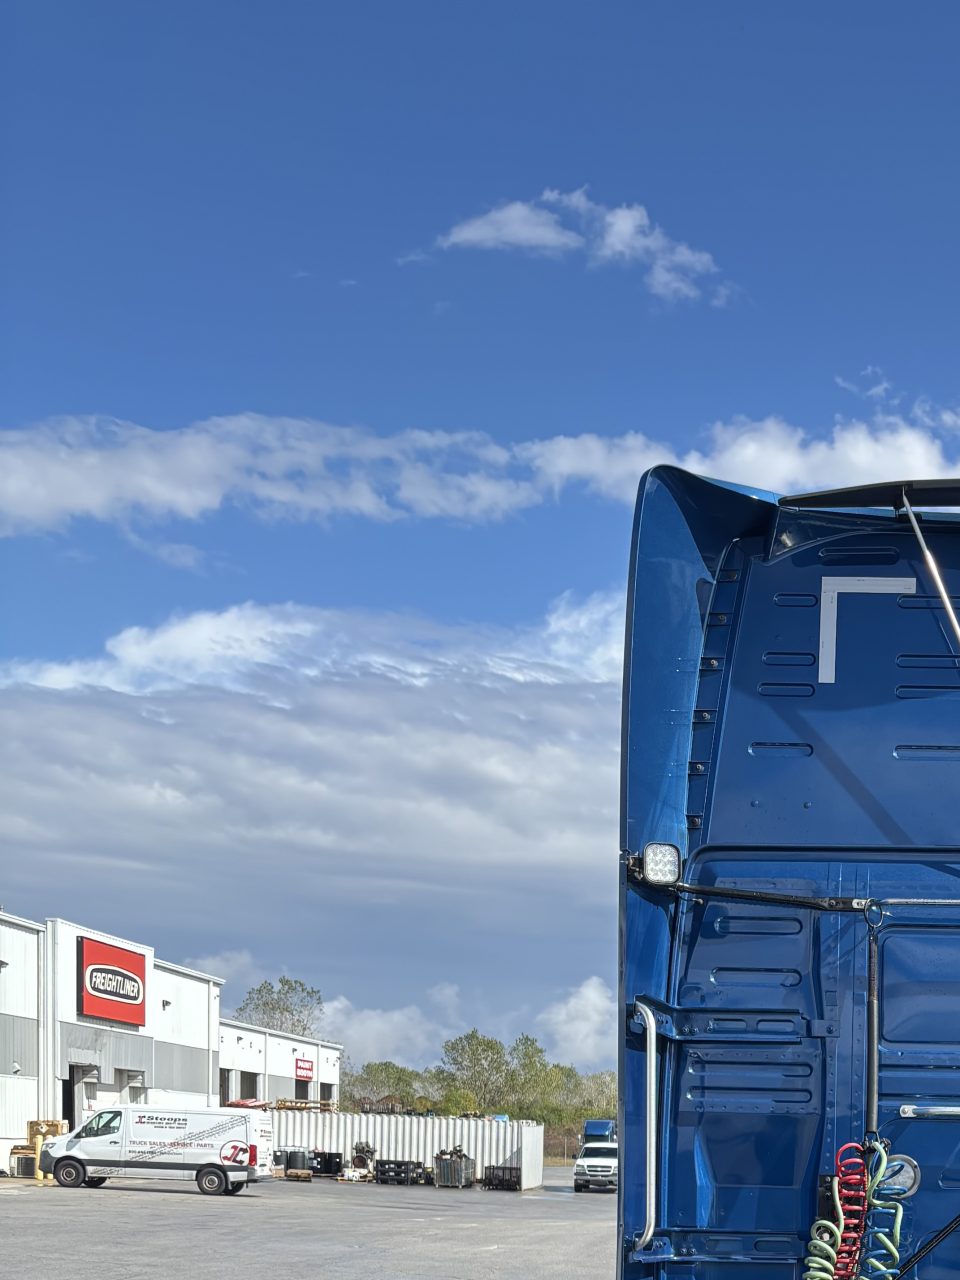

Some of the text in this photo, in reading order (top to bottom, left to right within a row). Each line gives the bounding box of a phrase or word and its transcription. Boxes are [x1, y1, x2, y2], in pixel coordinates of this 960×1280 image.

[91, 971, 139, 998] FREIGHTLINER
[297, 1060, 313, 1070] PAINT
[296, 1068, 313, 1078] BOOTH
[146, 1115, 188, 1123] Stoops
